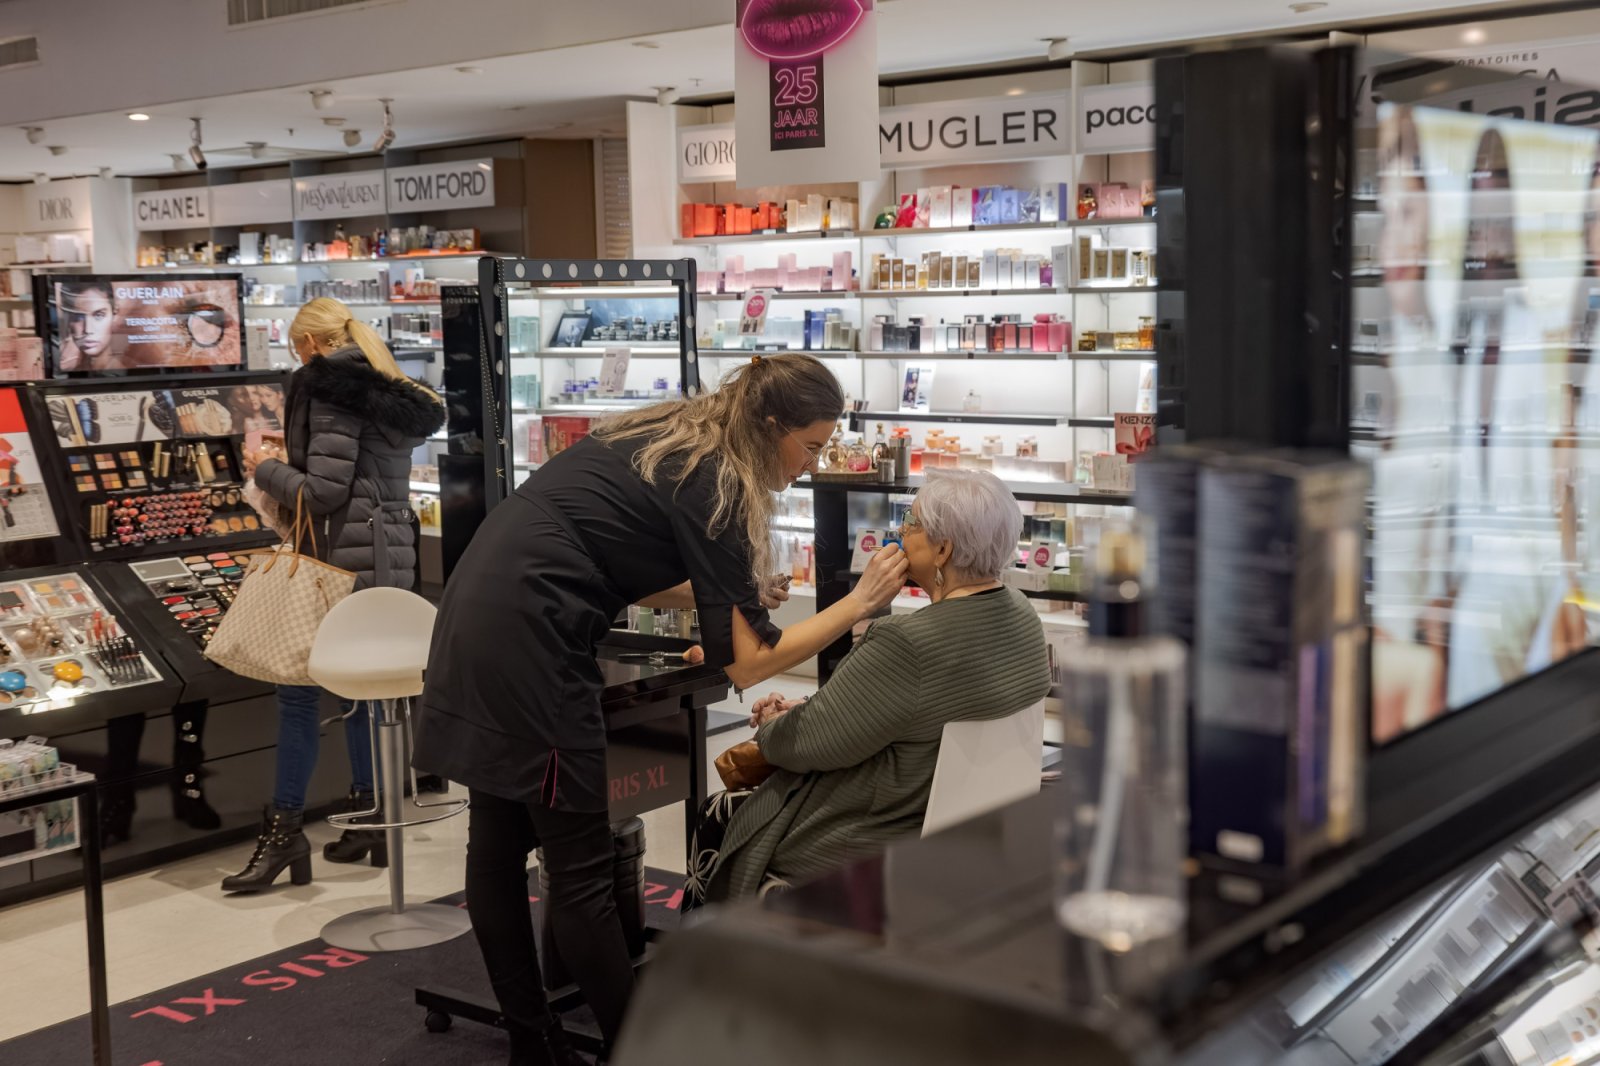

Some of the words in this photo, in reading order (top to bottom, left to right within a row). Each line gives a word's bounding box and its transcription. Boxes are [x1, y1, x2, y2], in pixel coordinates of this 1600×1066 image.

[774, 66, 818, 106] 25
[774, 107, 818, 128] JAAR
[774, 131, 784, 140] ICI
[785, 130, 807, 139] PARIS
[808, 128, 819, 137] XL
[879, 109, 1058, 154] MUGLER
[395, 174, 432, 202] TOM
[436, 170, 486, 199] FORD
[38, 197, 73, 222] DIOR
[137, 196, 205, 222] CHANEL
[116, 287, 184, 299] GUERLAIN
[182, 389, 219, 398] GUERLAIN
[609, 772, 640, 802] RIS
[646, 764, 668, 790] XL
[129, 987, 248, 1023] XL
